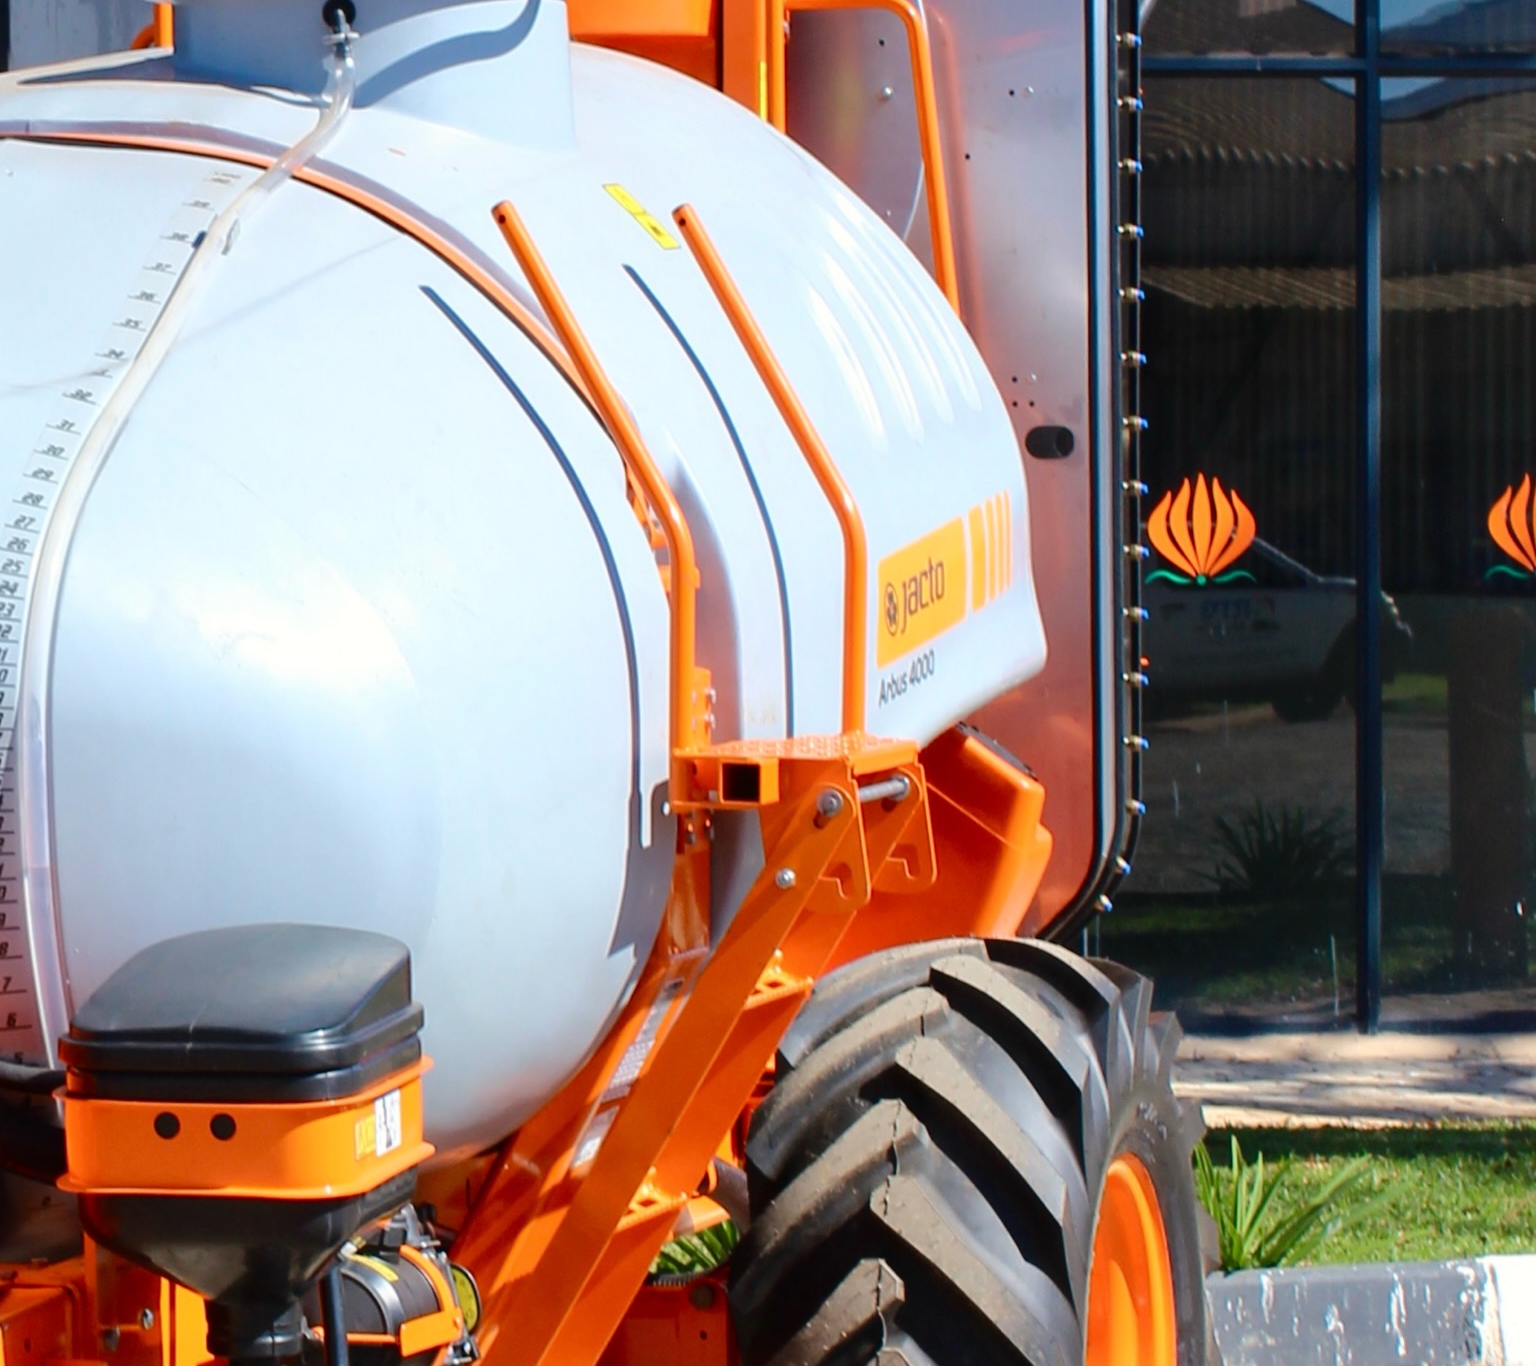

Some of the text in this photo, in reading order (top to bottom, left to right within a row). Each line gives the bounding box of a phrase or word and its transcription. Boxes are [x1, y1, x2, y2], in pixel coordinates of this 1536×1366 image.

[21, 491, 45, 506] 28
[13, 515, 36, 530] 27
[7, 536, 30, 552] 26
[1, 558, 25, 574] 25
[878, 649, 935, 707] Arbus 4000
[2, 976, 12, 992] 7
[6, 1012, 17, 1028] 6
